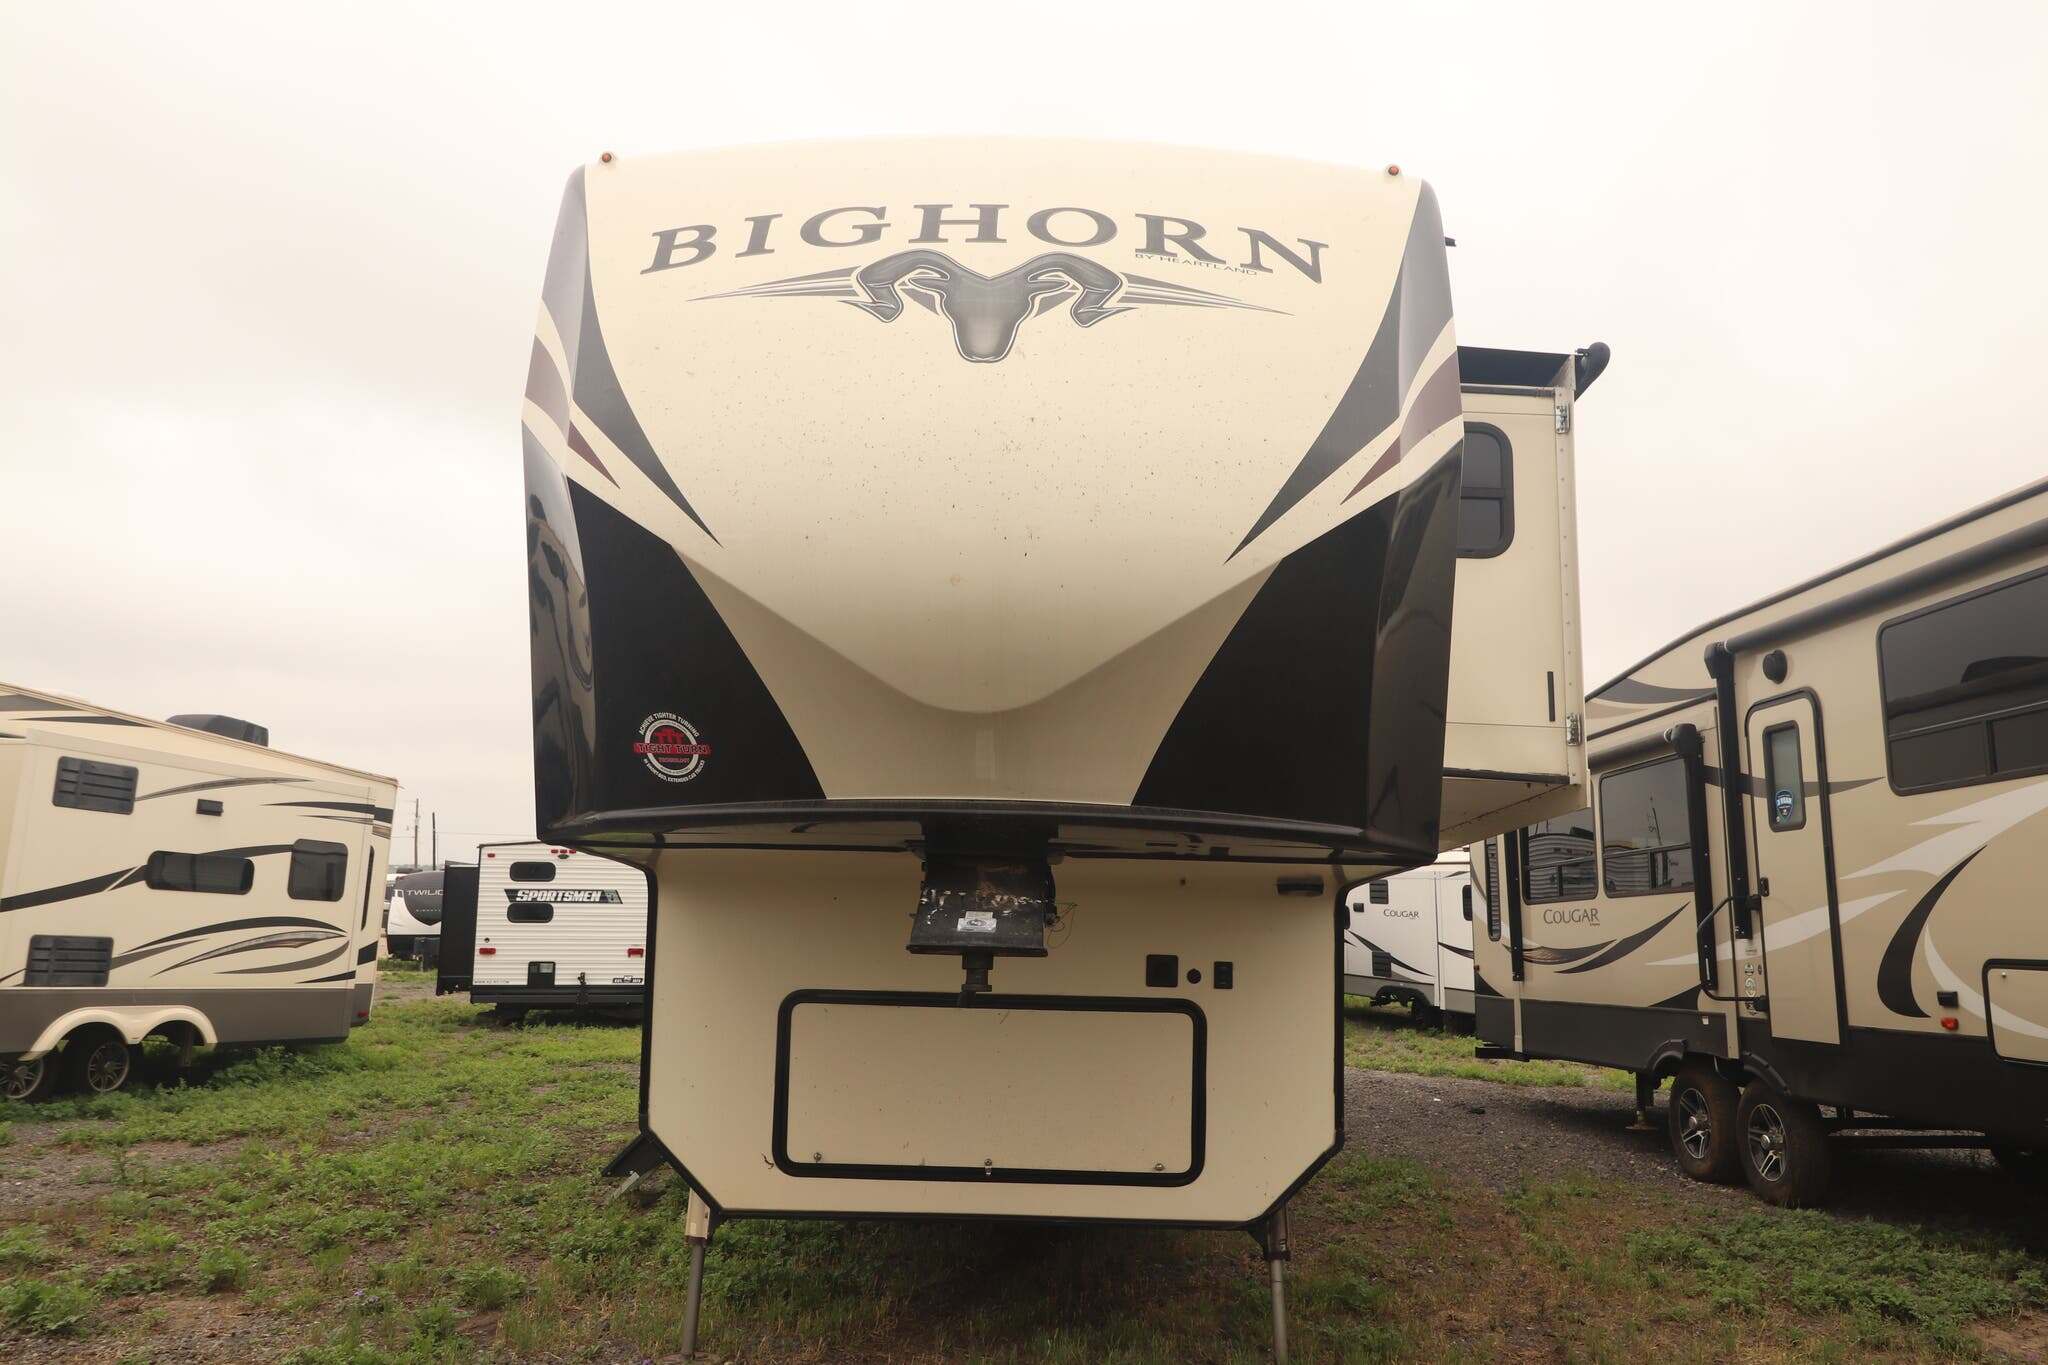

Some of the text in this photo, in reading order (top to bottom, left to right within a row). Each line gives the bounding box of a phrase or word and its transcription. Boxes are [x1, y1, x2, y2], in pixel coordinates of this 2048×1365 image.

[640, 203, 1330, 284] BIGHORN
[1159, 256, 1257, 276] HEARTLAND
[638, 743, 709, 754] TIGHT TURN
[516, 889, 601, 902] SPORTSMEN
[1383, 909, 1420, 918] COUGAR
[1543, 908, 1600, 924] COUGAR
